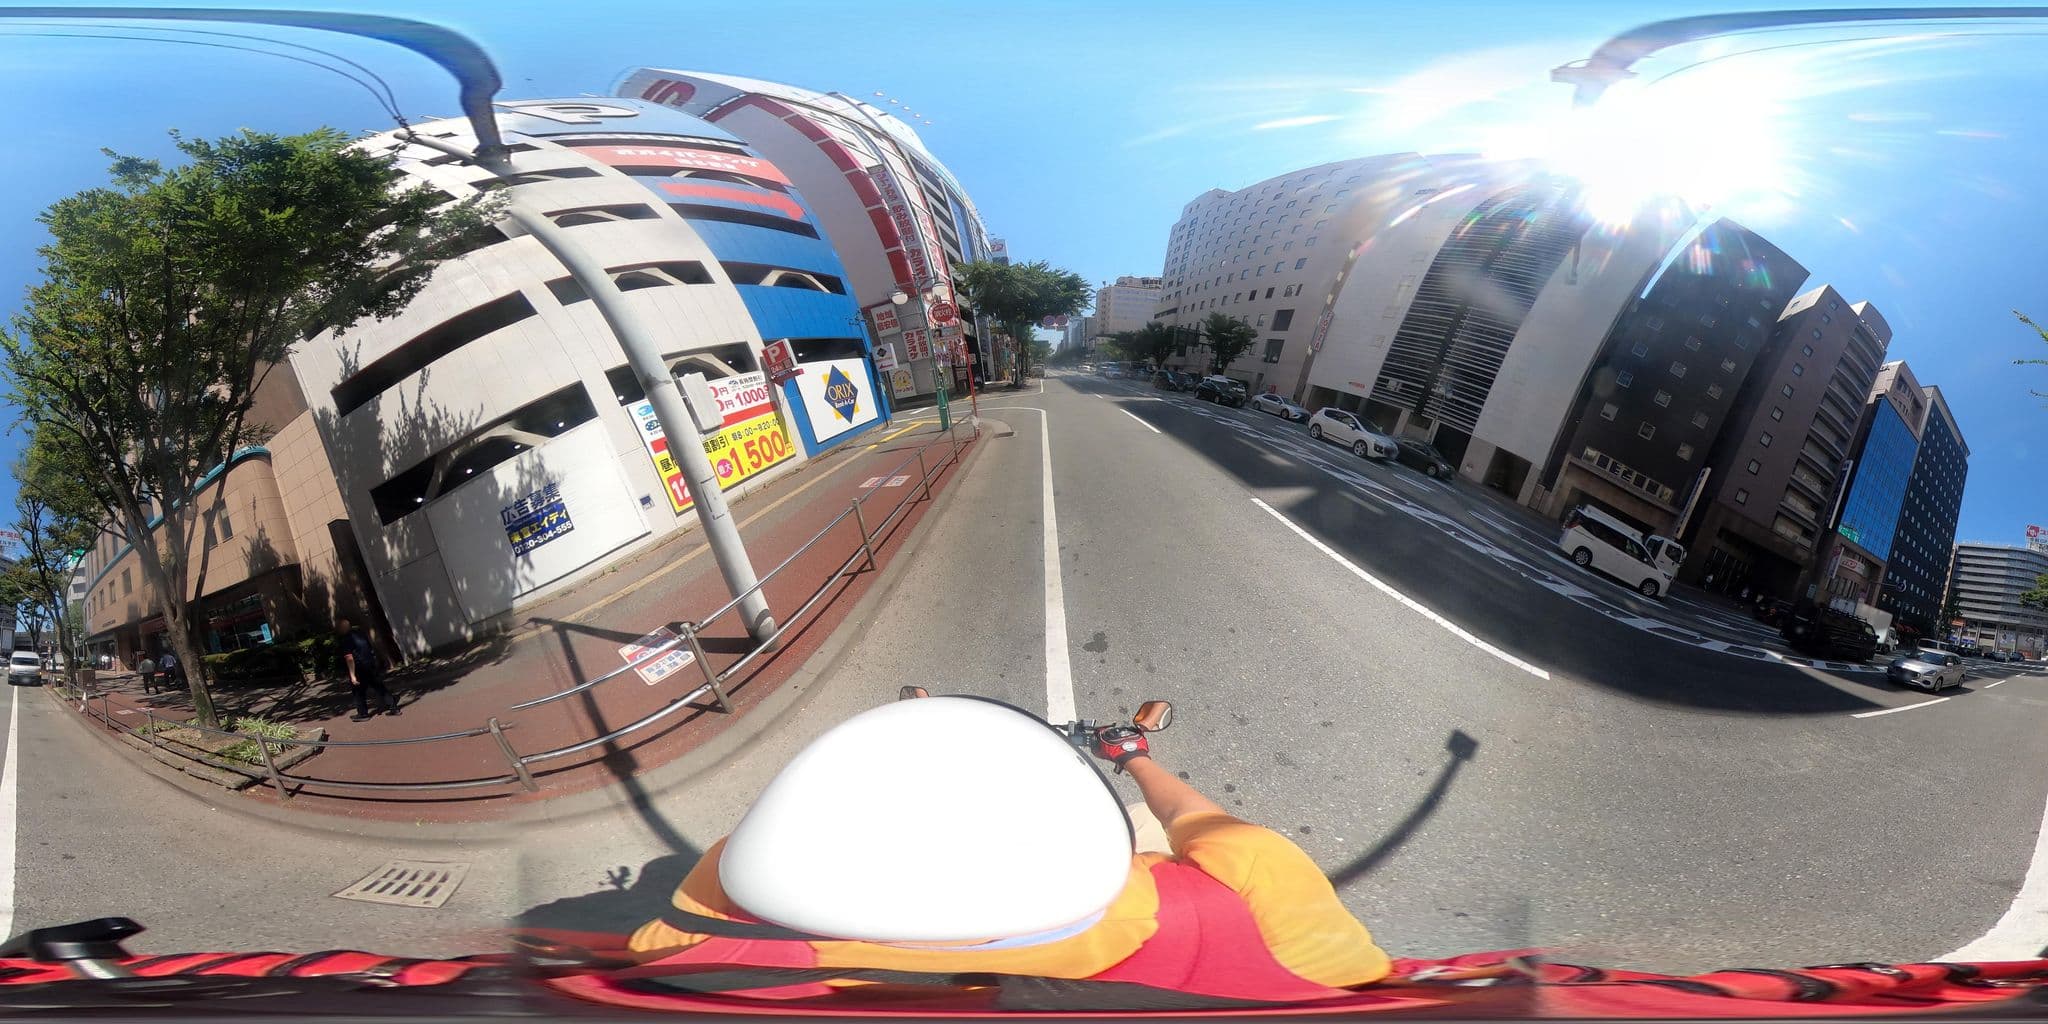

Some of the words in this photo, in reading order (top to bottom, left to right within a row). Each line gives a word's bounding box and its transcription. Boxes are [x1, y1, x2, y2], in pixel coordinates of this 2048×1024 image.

[768, 345, 782, 363] P
[904, 332, 918, 360] カラオケ
[828, 383, 855, 401] ORIX
[501, 482, 561, 526] 広告募集
[514, 520, 572, 554] 0120-304-555
